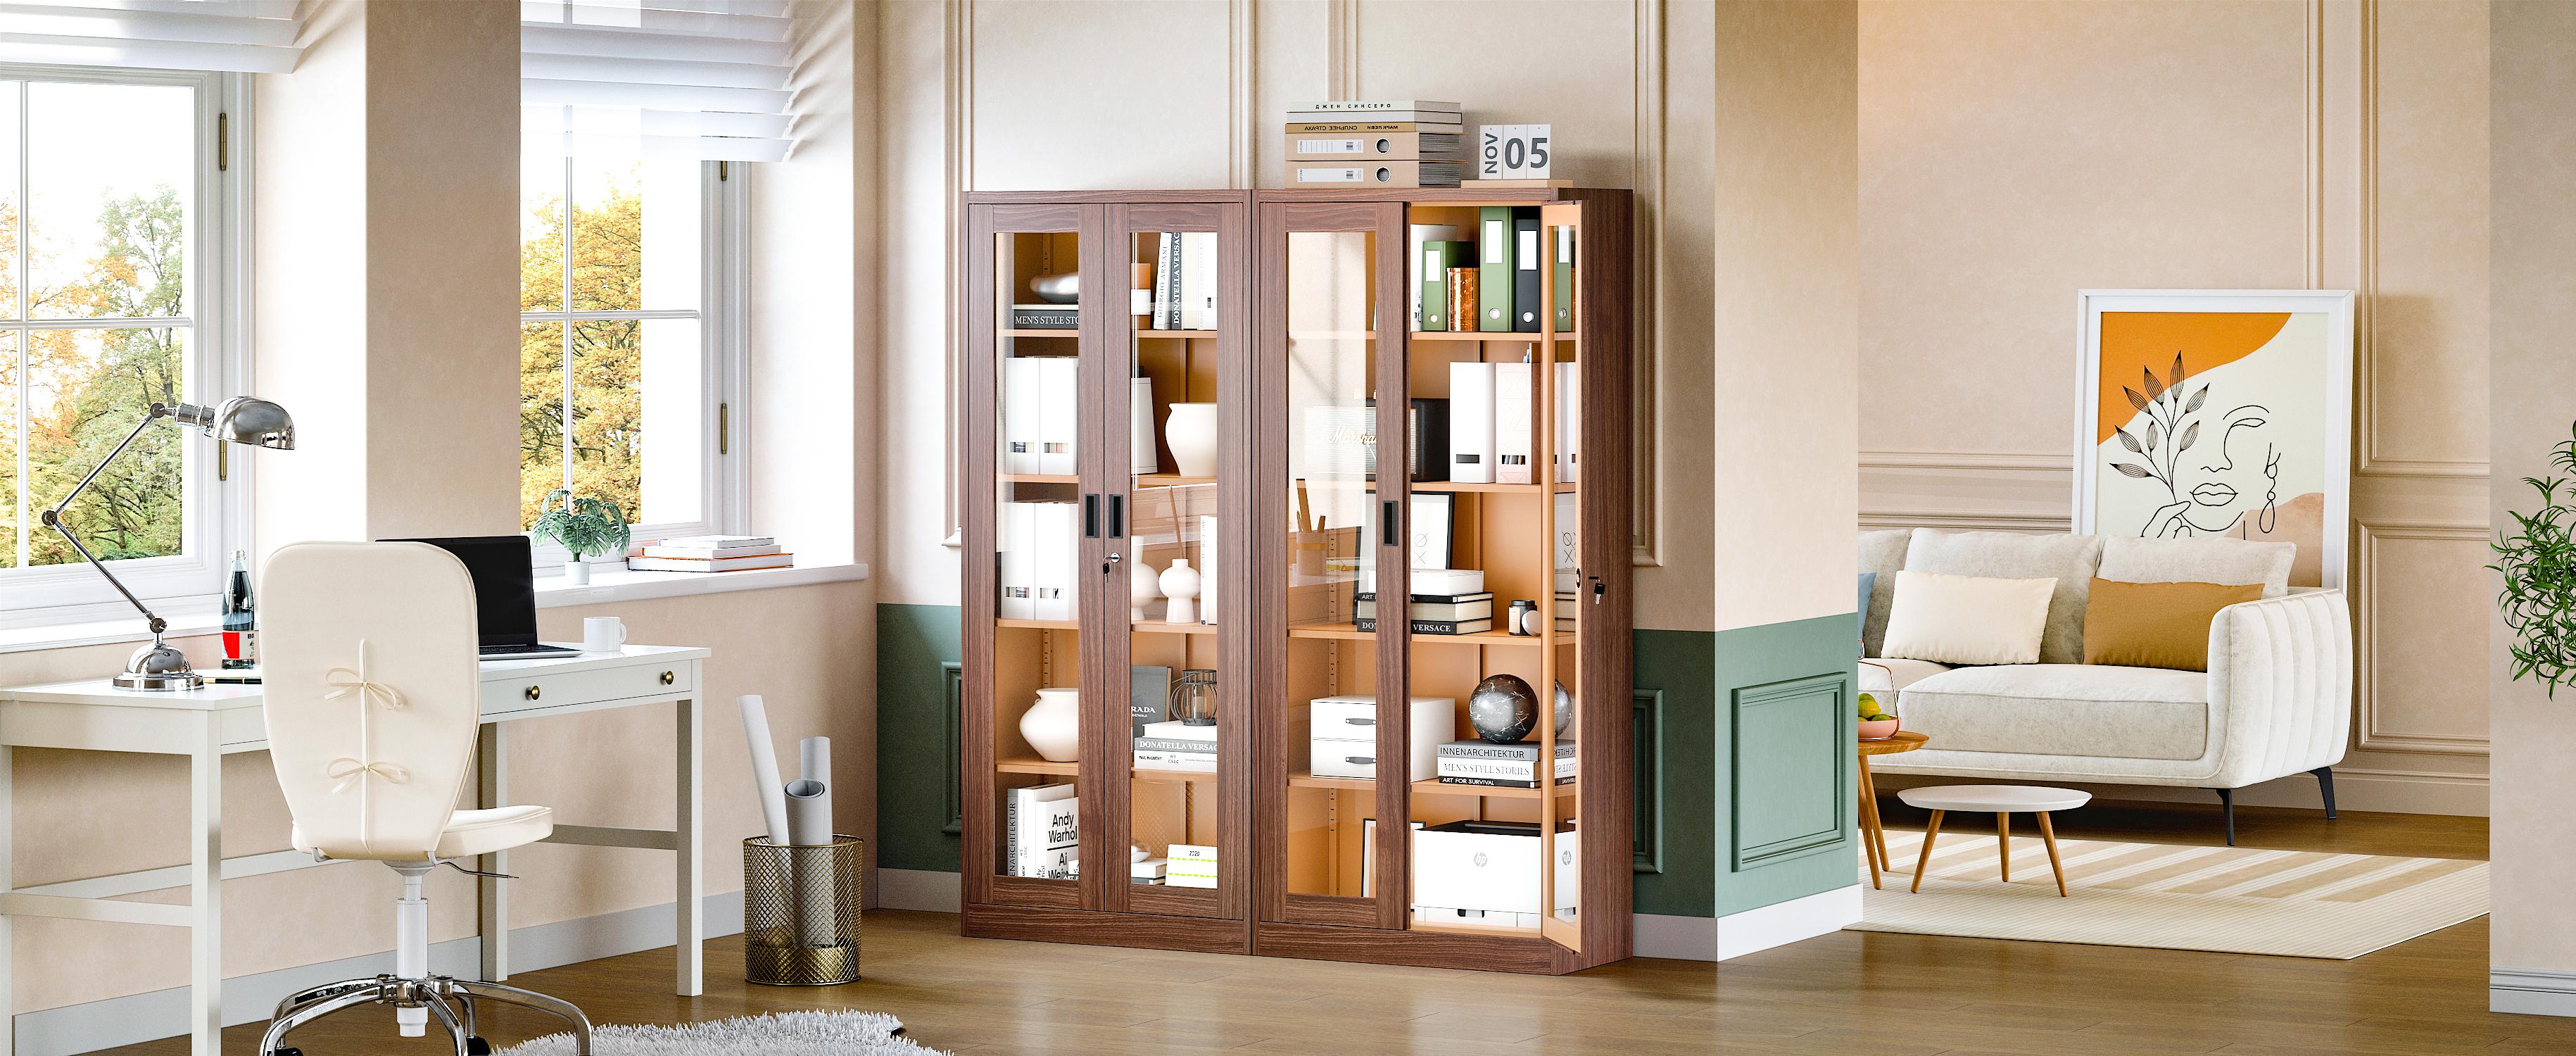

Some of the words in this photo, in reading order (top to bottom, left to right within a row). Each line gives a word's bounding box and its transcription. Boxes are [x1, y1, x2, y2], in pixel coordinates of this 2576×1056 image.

[1484, 132, 1498, 174] NOV
[1015, 315, 1038, 325] MEN'S
[1040, 316, 1064, 325] STYLE
[1413, 624, 1451, 632] VERSACE
[1139, 741, 1187, 750] DONATELLA
[1188, 743, 1217, 752] VERSAC
[1439, 747, 1524, 758] INNENARCHITEKTUR
[1444, 763, 1467, 772] MEN'S
[1470, 765, 1494, 774] STYLE
[1496, 766, 1529, 776] STORIES
[1052, 811, 1074, 829] Andy
[1048, 826, 1078, 843] Warhol
[1059, 853, 1067, 866] Ai
[1474, 852, 1488, 867] hp
